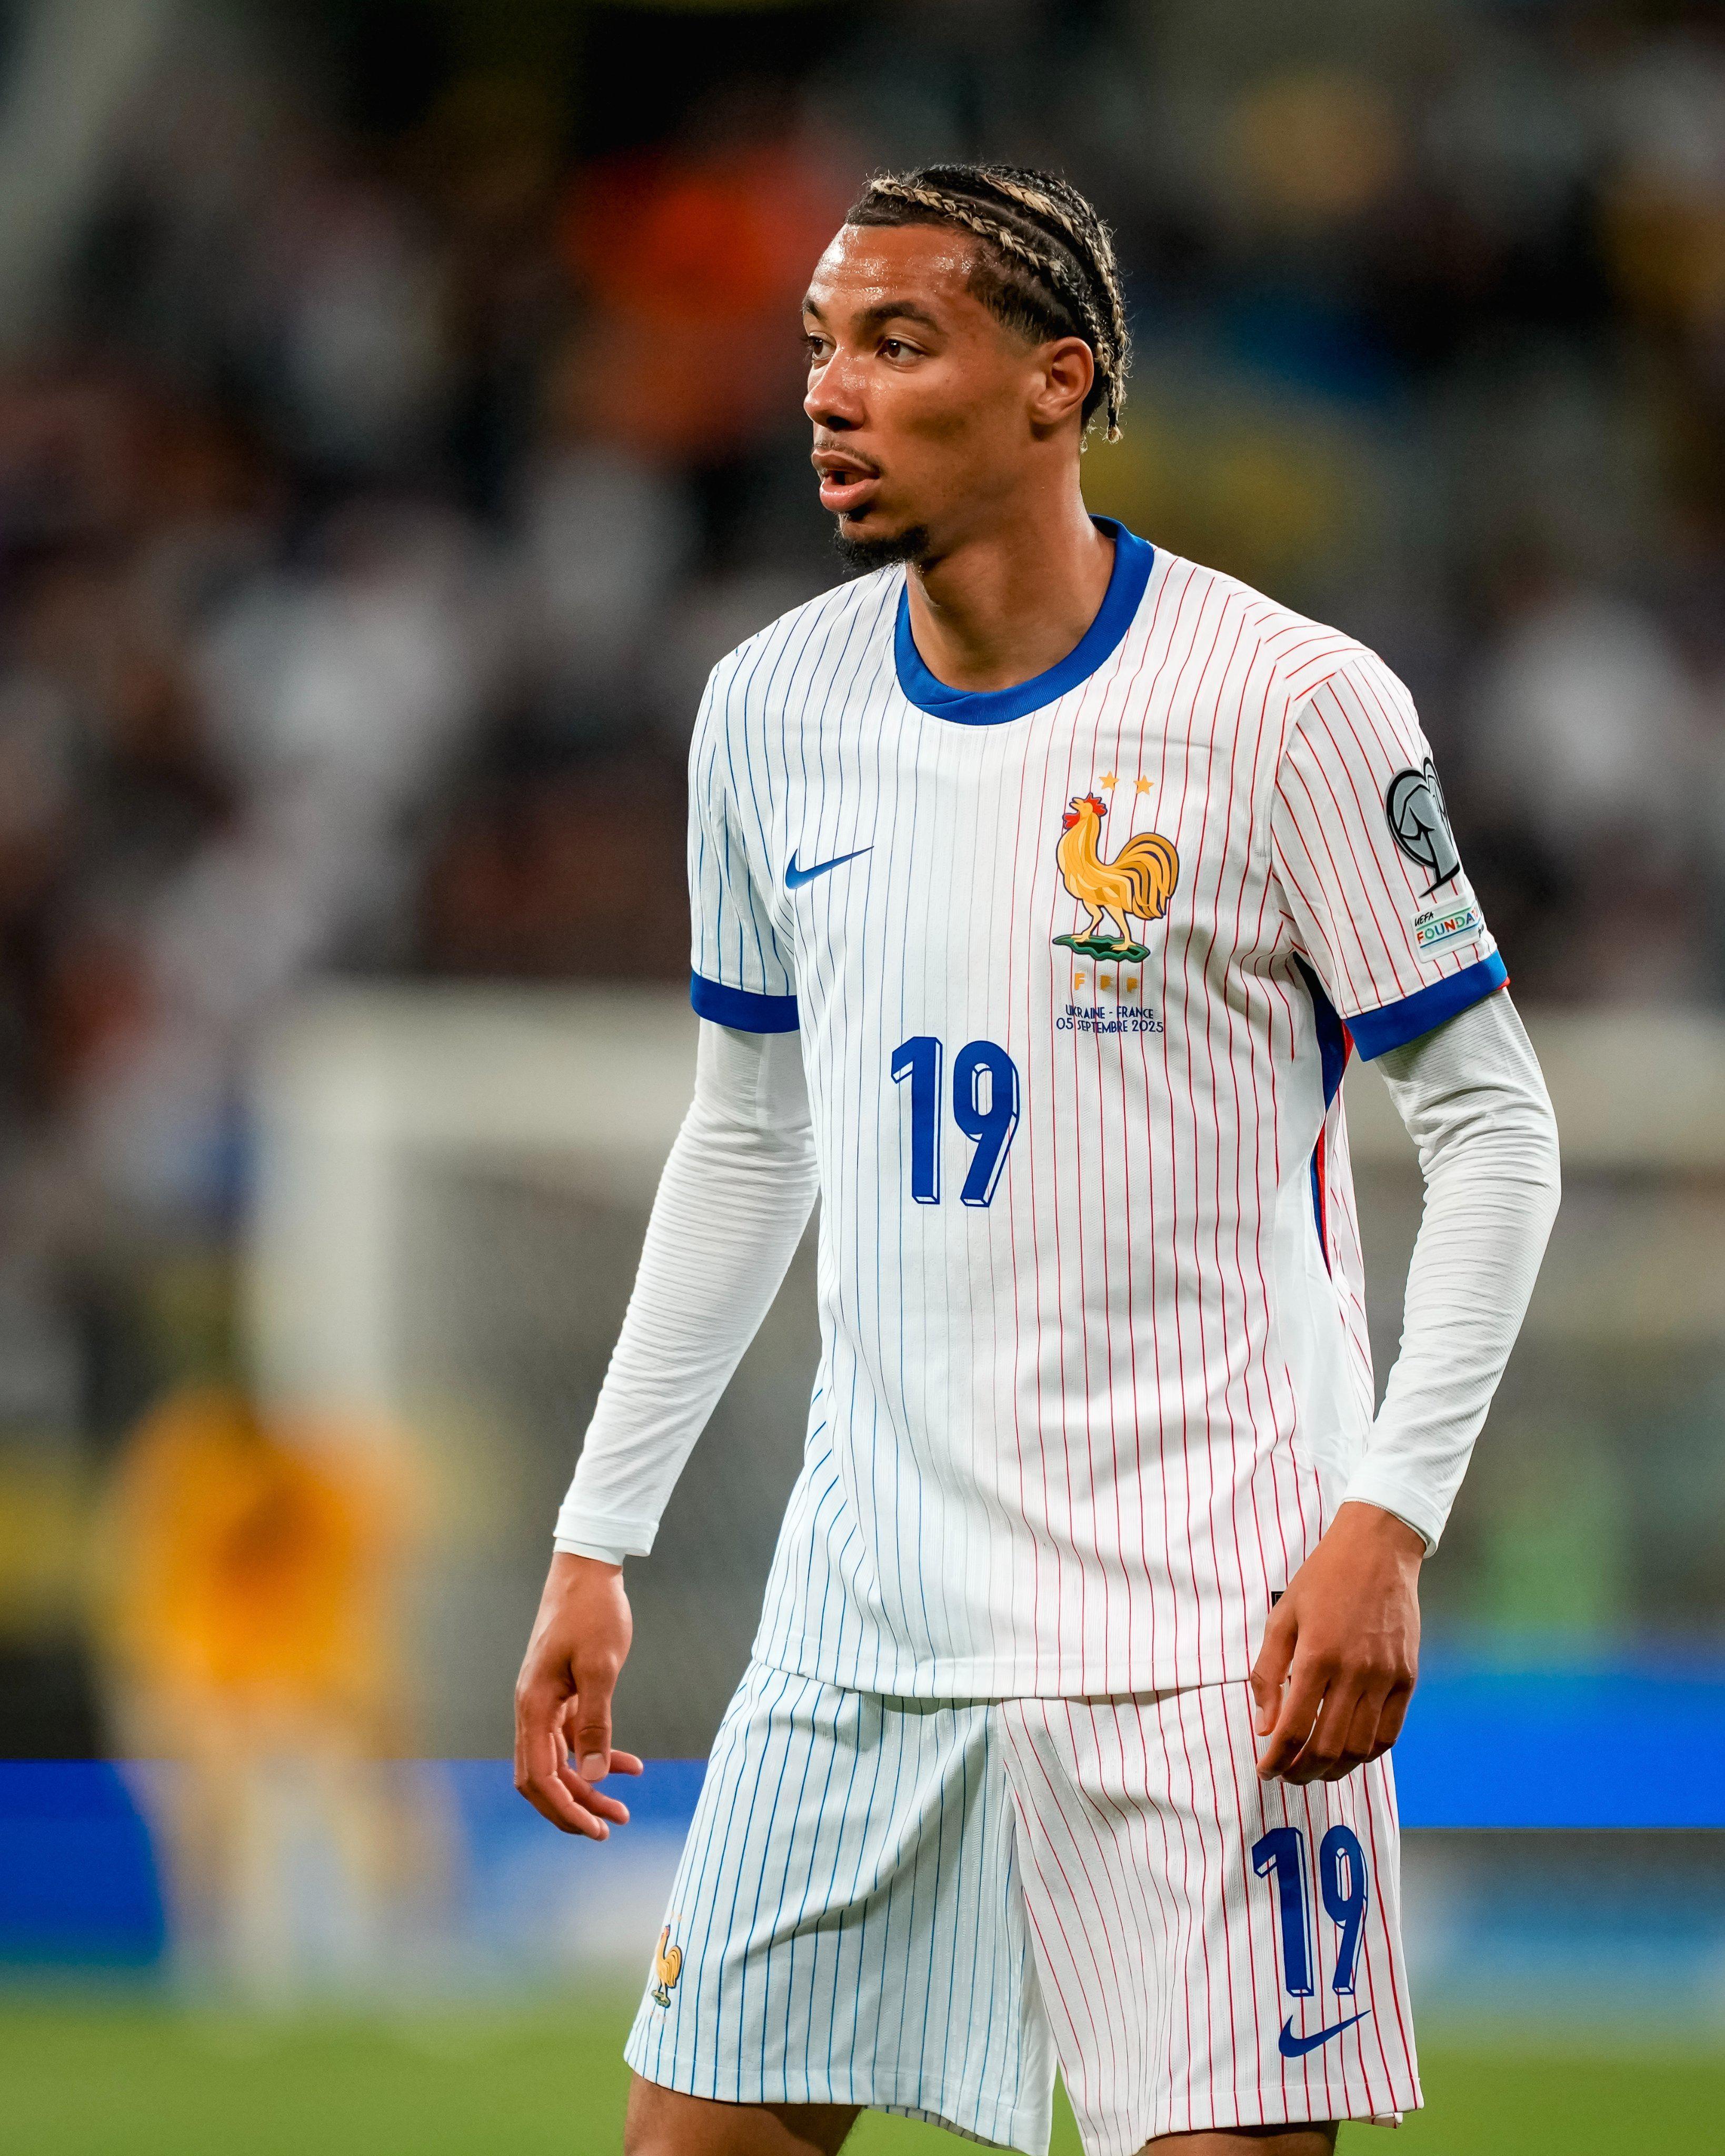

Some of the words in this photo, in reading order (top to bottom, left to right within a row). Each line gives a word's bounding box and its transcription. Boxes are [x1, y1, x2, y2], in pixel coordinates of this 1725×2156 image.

[1414, 911, 1434, 927] UEFA
[1065, 1004, 1105, 1019] UKRAINE
[1116, 1006, 1154, 1019] FRANCE
[1056, 1017, 1073, 1030] 05
[1077, 1020, 1128, 1033] SEPTEMBRE
[1132, 1020, 1164, 1033] 2025
[891, 1036, 1020, 1207] 19
[1252, 1825, 1368, 1998] 19
